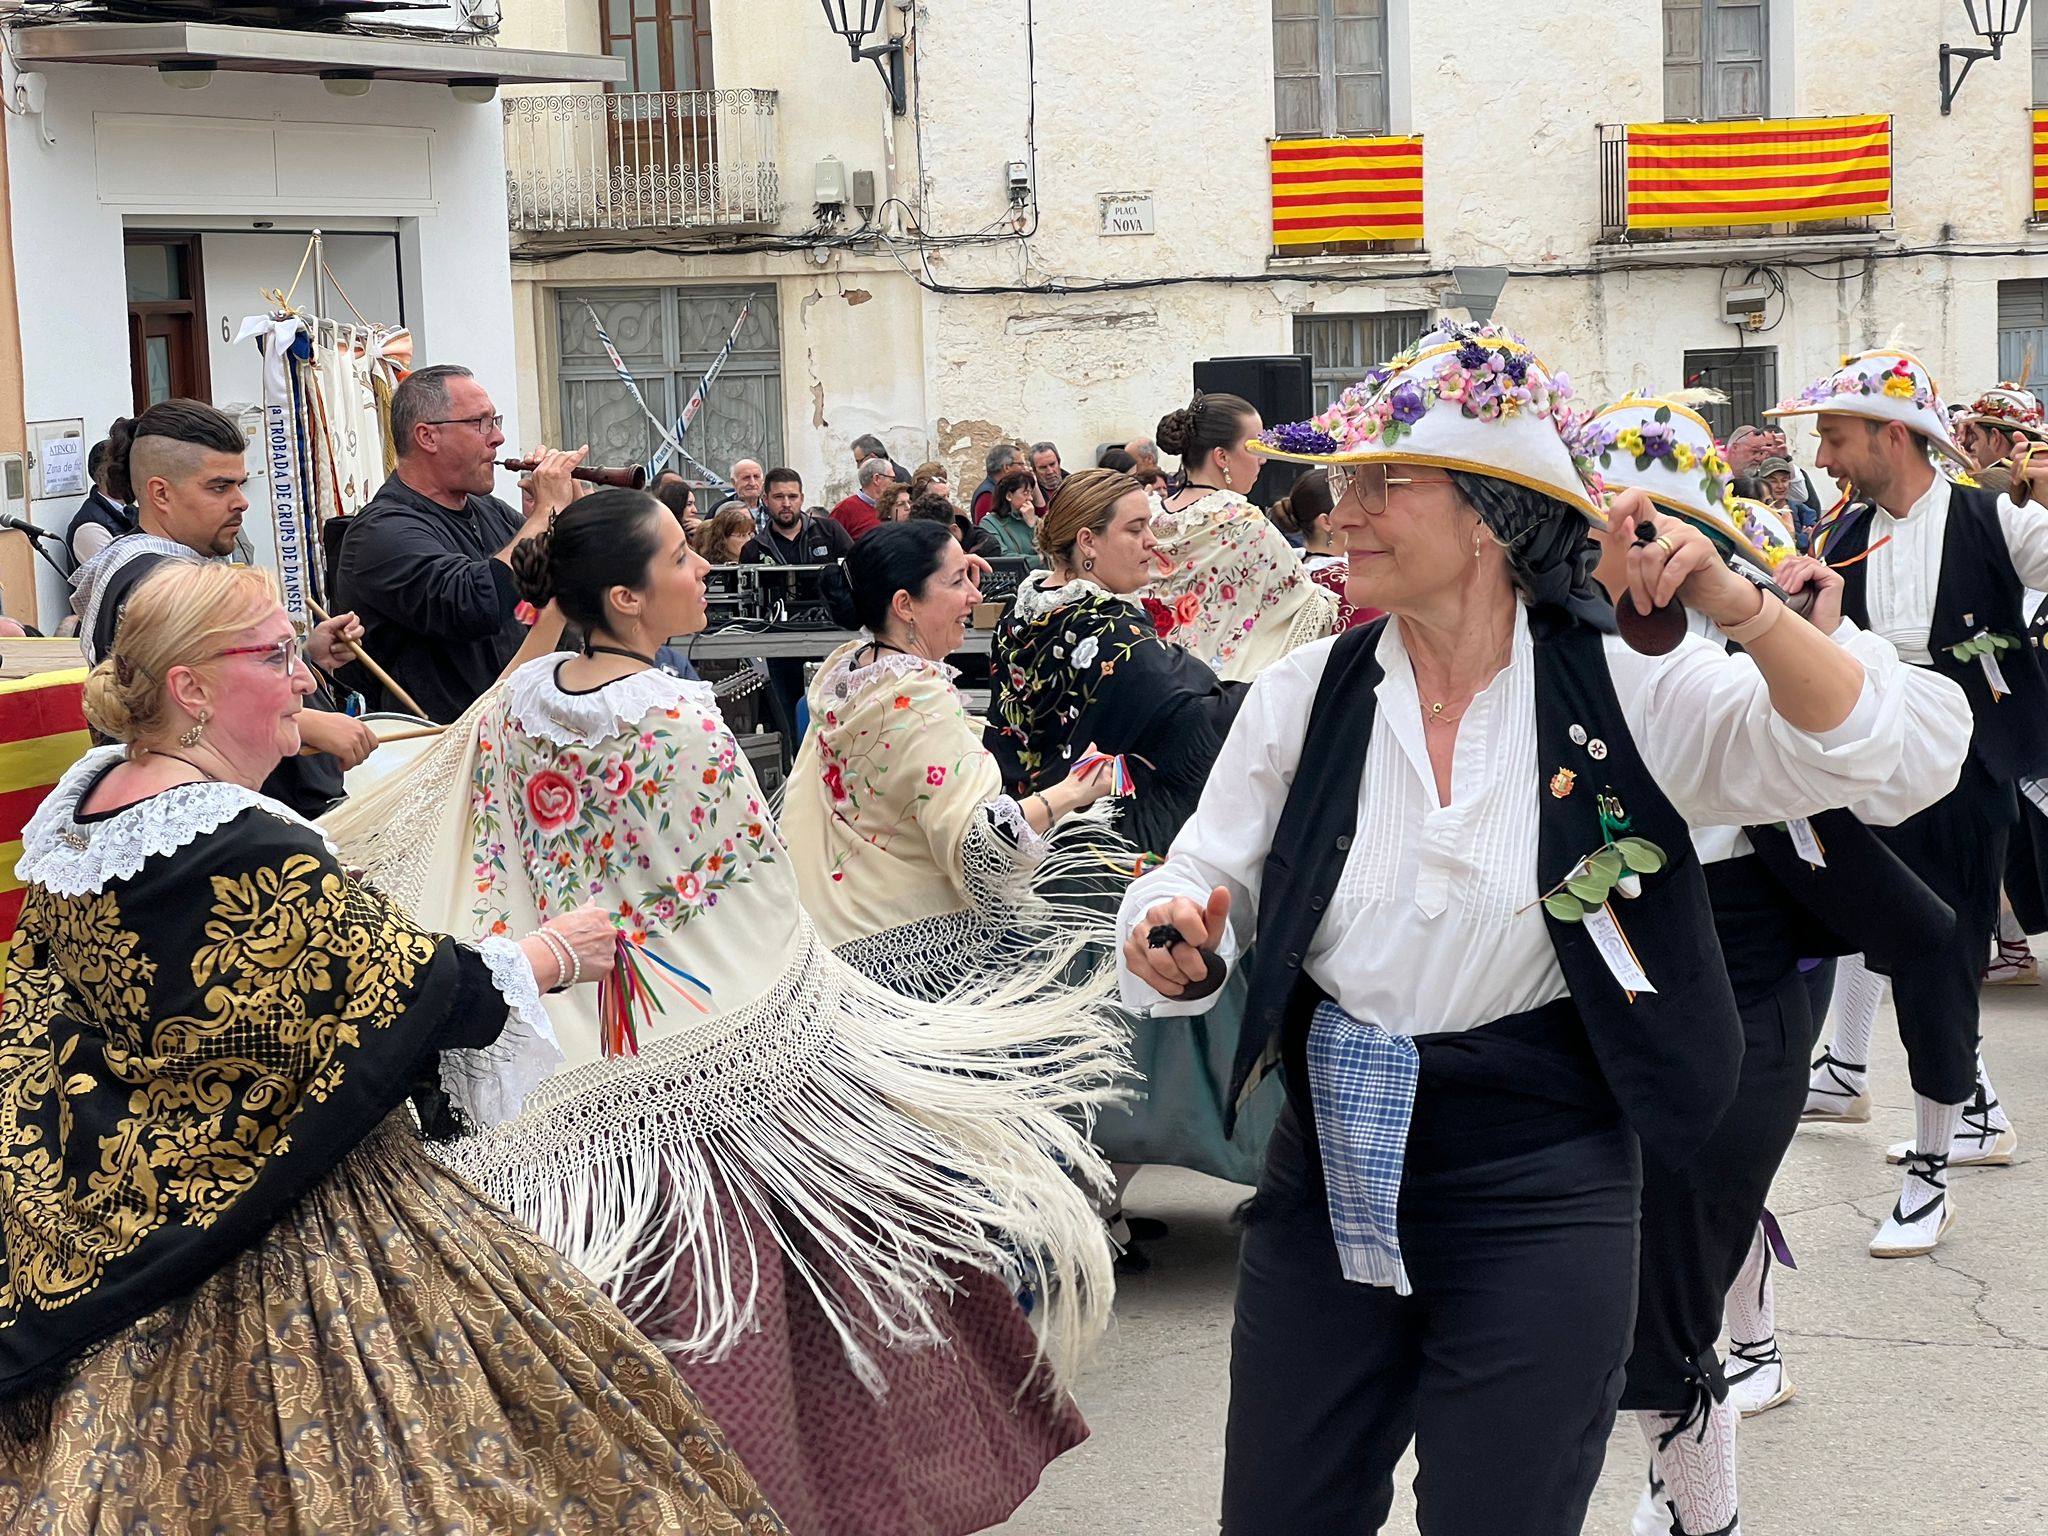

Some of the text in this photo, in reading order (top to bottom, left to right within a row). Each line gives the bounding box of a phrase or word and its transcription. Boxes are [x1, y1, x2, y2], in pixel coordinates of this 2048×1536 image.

[1115, 206, 1137, 215] PLAÇA
[1113, 219, 1143, 231] NOVA
[221, 315, 230, 343] 6
[270, 419, 289, 478] TROBADA
[63, 461, 73, 472] de
[275, 483, 292, 500] DE
[277, 503, 295, 542] GRUPS
[282, 546, 297, 562] DE
[284, 565, 301, 613] DANSES
